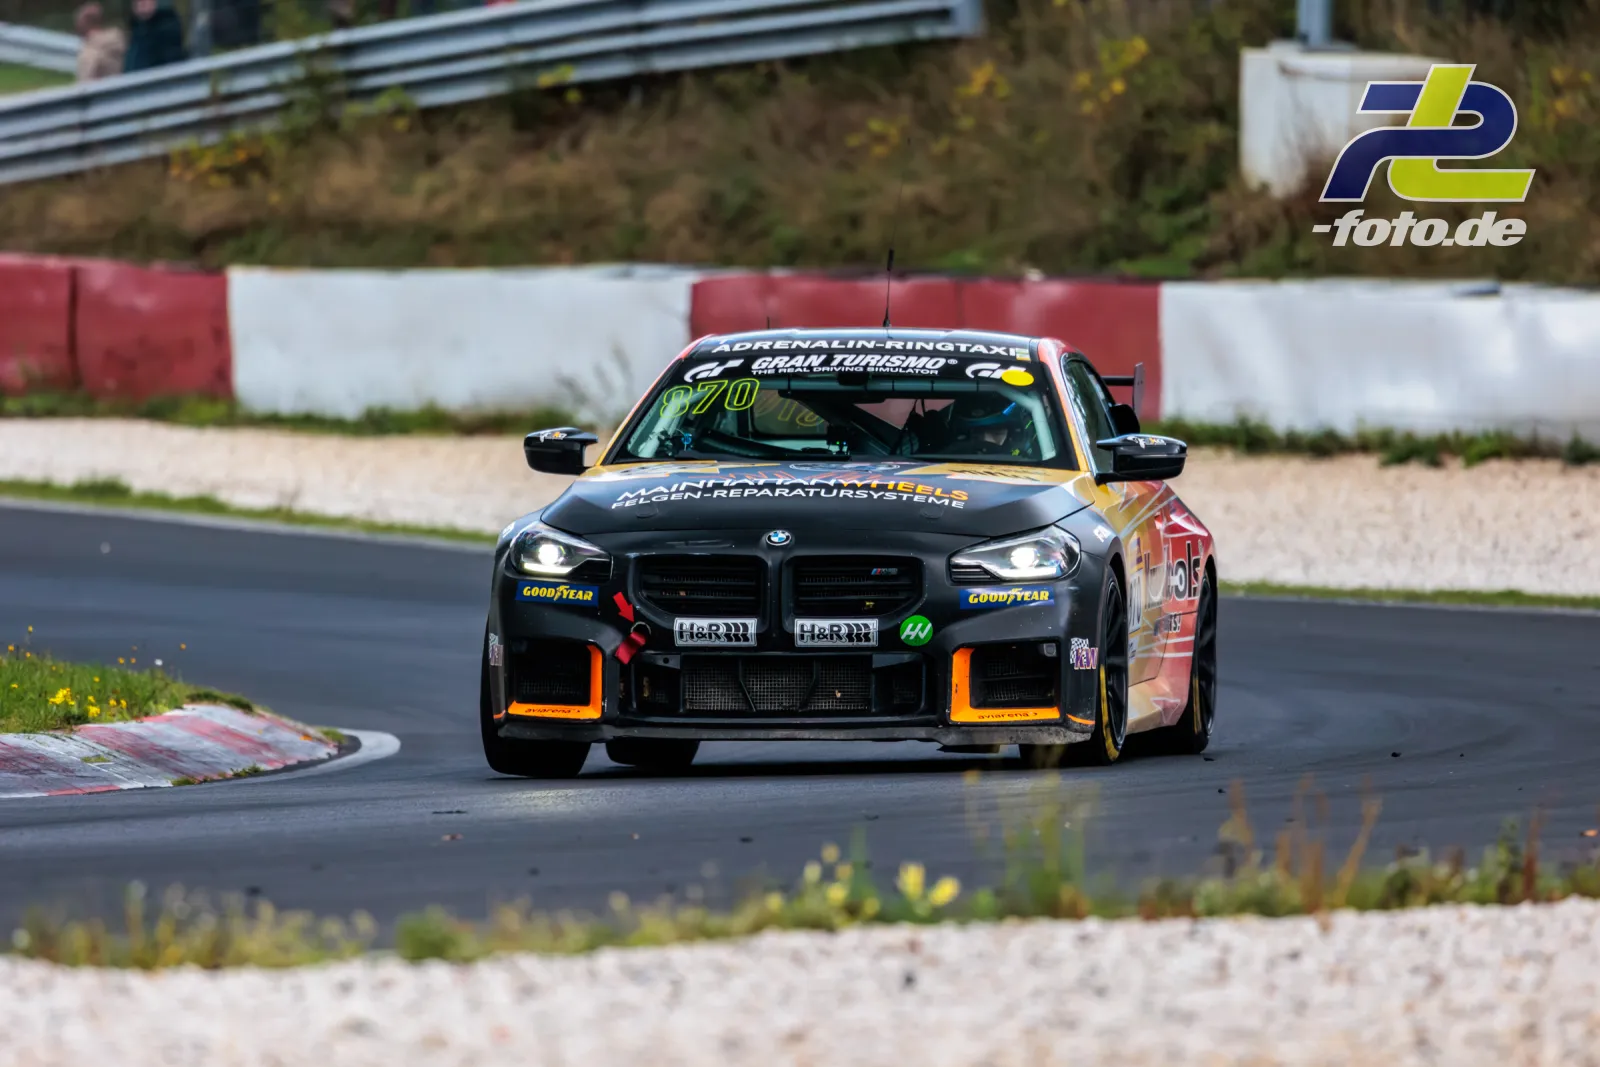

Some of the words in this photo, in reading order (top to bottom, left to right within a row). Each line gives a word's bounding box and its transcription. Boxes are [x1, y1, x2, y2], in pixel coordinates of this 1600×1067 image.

[751, 355, 827, 370] GRAN
[866, 366, 939, 375] SIMULATOR
[660, 378, 760, 419] 870
[611, 488, 966, 509] FELGEN-REPARATURSYSTEME
[522, 585, 594, 601] GOODYEAR
[968, 588, 1050, 605] GOODYEAR
[679, 622, 724, 643] H&R
[800, 623, 847, 643] H&R
